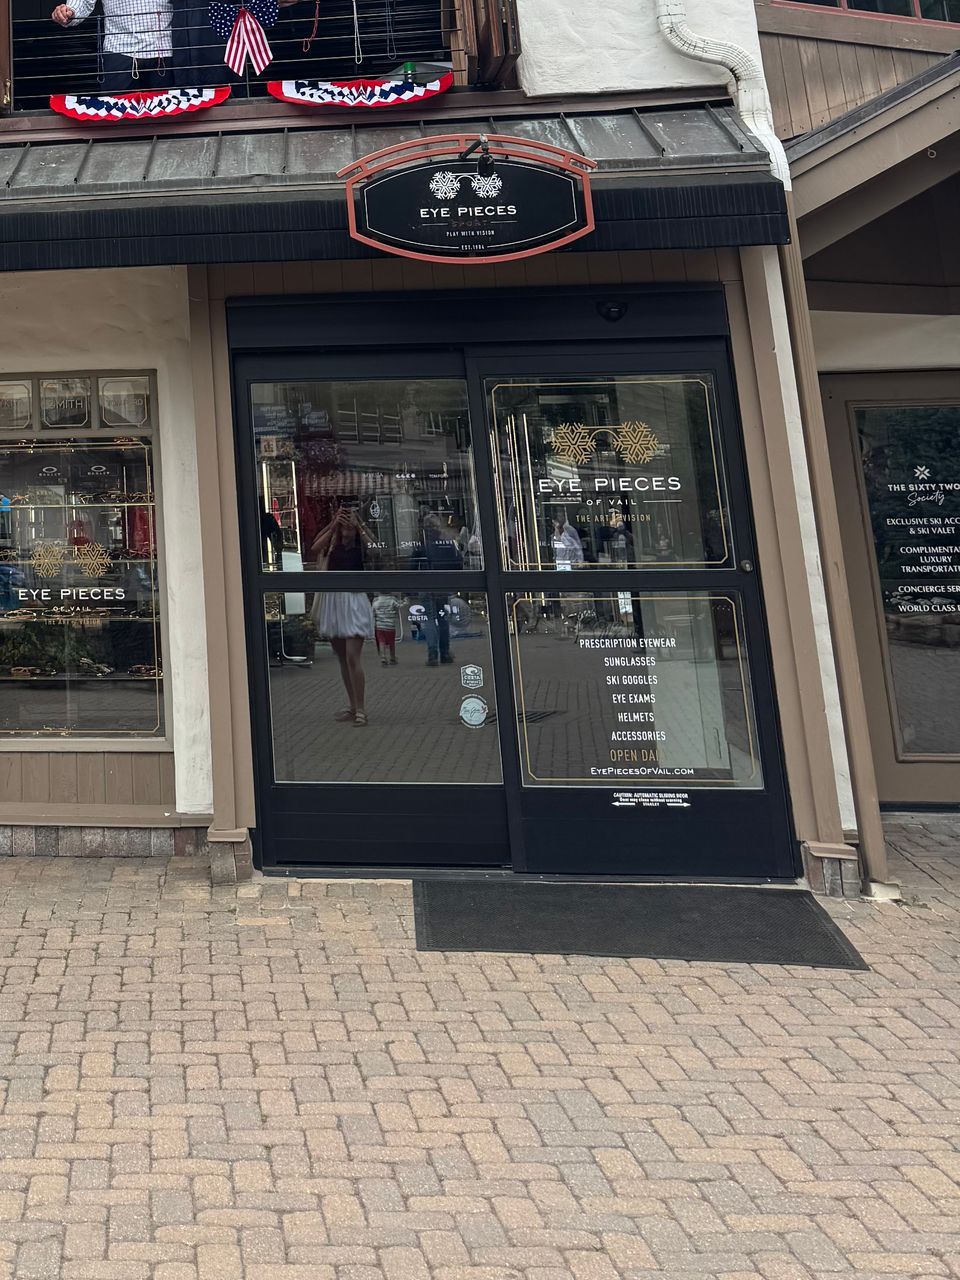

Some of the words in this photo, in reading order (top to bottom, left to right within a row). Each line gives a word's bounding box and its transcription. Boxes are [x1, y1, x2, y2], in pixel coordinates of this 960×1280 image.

[420, 208, 450, 218] EYE
[458, 205, 517, 217] PIECES
[539, 479, 583, 492] EYE
[594, 477, 681, 492] PIECES
[888, 484, 906, 492] THE
[908, 483, 936, 492] SIXTY
[938, 483, 960, 491] TWO
[907, 490, 945, 507] Society
[576, 514, 591, 523] THE
[594, 514, 609, 522] ART
[622, 513, 651, 522] VISION
[886, 518, 928, 526] EXCLUSIVE
[929, 518, 942, 526] SKI
[909, 527, 916, 535] &
[917, 527, 930, 535] SKI
[931, 526, 956, 535] VALET
[900, 546, 960, 554] COMPLIMENTA
[920, 556, 952, 564] LUXURY
[18, 589, 51, 600] EYE
[60, 588, 126, 600] PIECES
[898, 585, 946, 593] CONCIERGE
[898, 605, 930, 613] WORLD
[931, 604, 956, 612] CLASS
[579, 638, 637, 649] PRESCRIPTION
[639, 638, 676, 648] EYEWEAR
[604, 656, 656, 667] SUNGLASSES
[606, 675, 620, 685] SKI
[622, 675, 658, 685] GOGGLES
[612, 694, 626, 704] EYE
[628, 693, 656, 703] EXAMS
[618, 712, 655, 722] HELMETS
[611, 731, 666, 741] ACCESSORIES
[610, 749, 638, 762] OPEN
